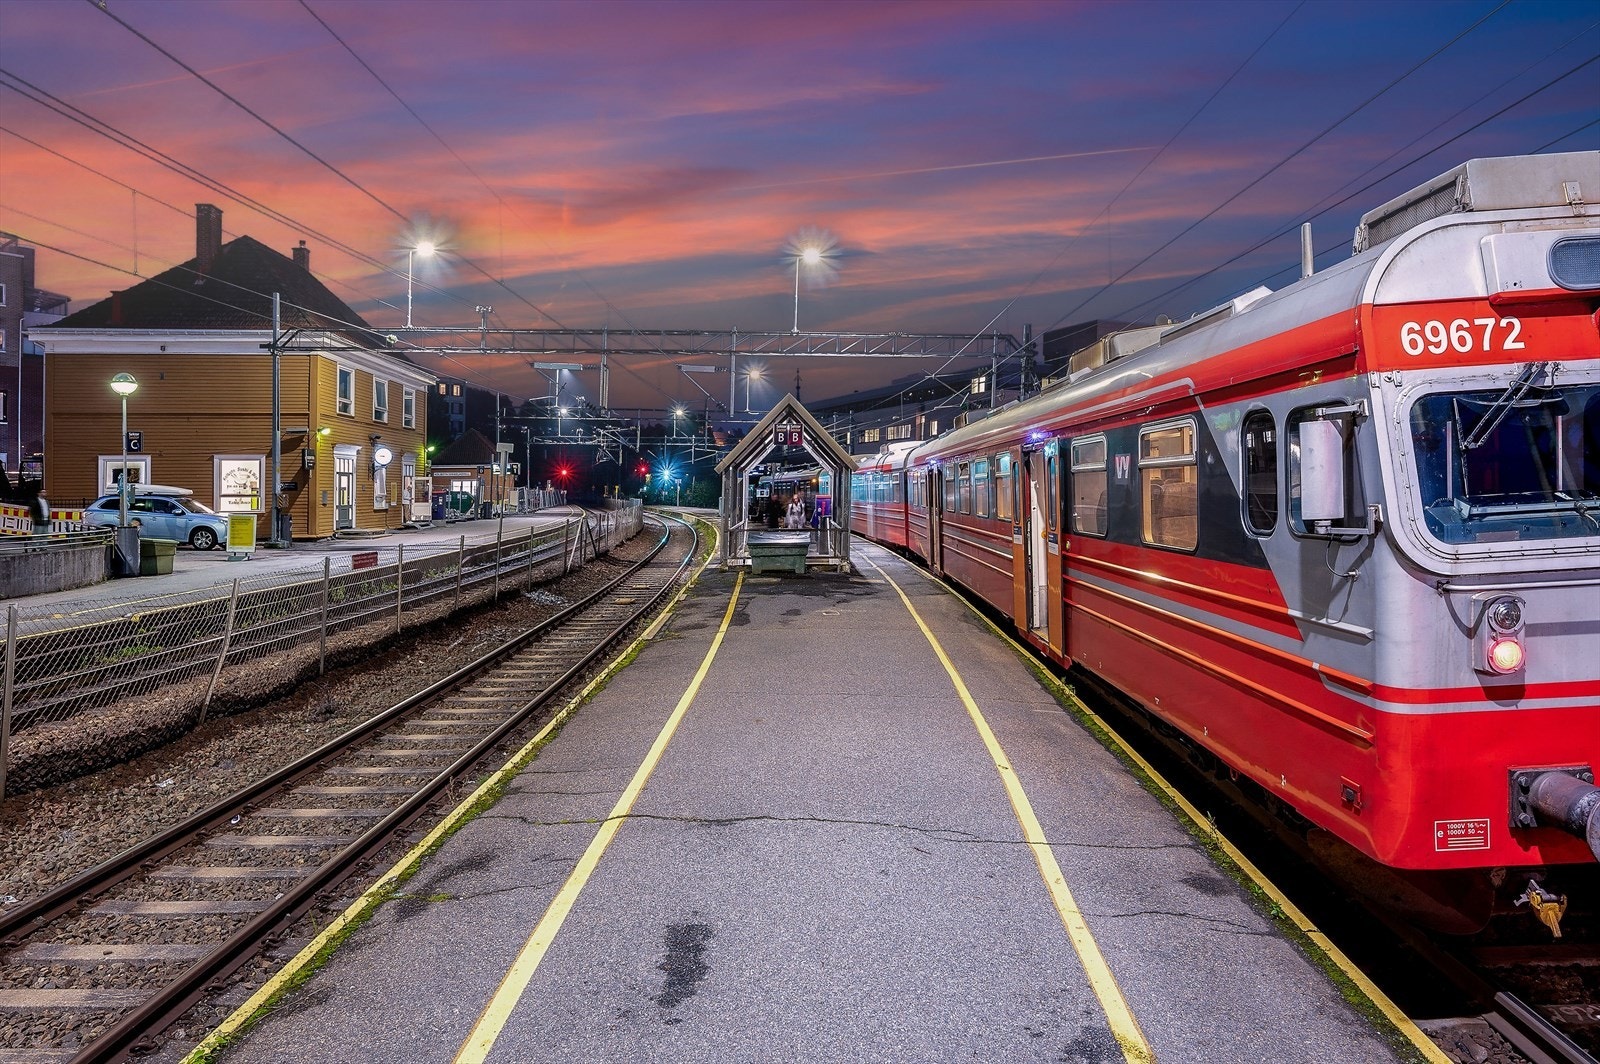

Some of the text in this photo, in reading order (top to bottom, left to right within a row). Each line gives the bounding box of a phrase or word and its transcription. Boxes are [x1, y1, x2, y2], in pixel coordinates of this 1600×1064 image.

[1400, 316, 1526, 356] 69672
[778, 432, 784, 442] B
[792, 432, 799, 442] B
[131, 440, 138, 449] C
[1437, 830, 1444, 838] e
